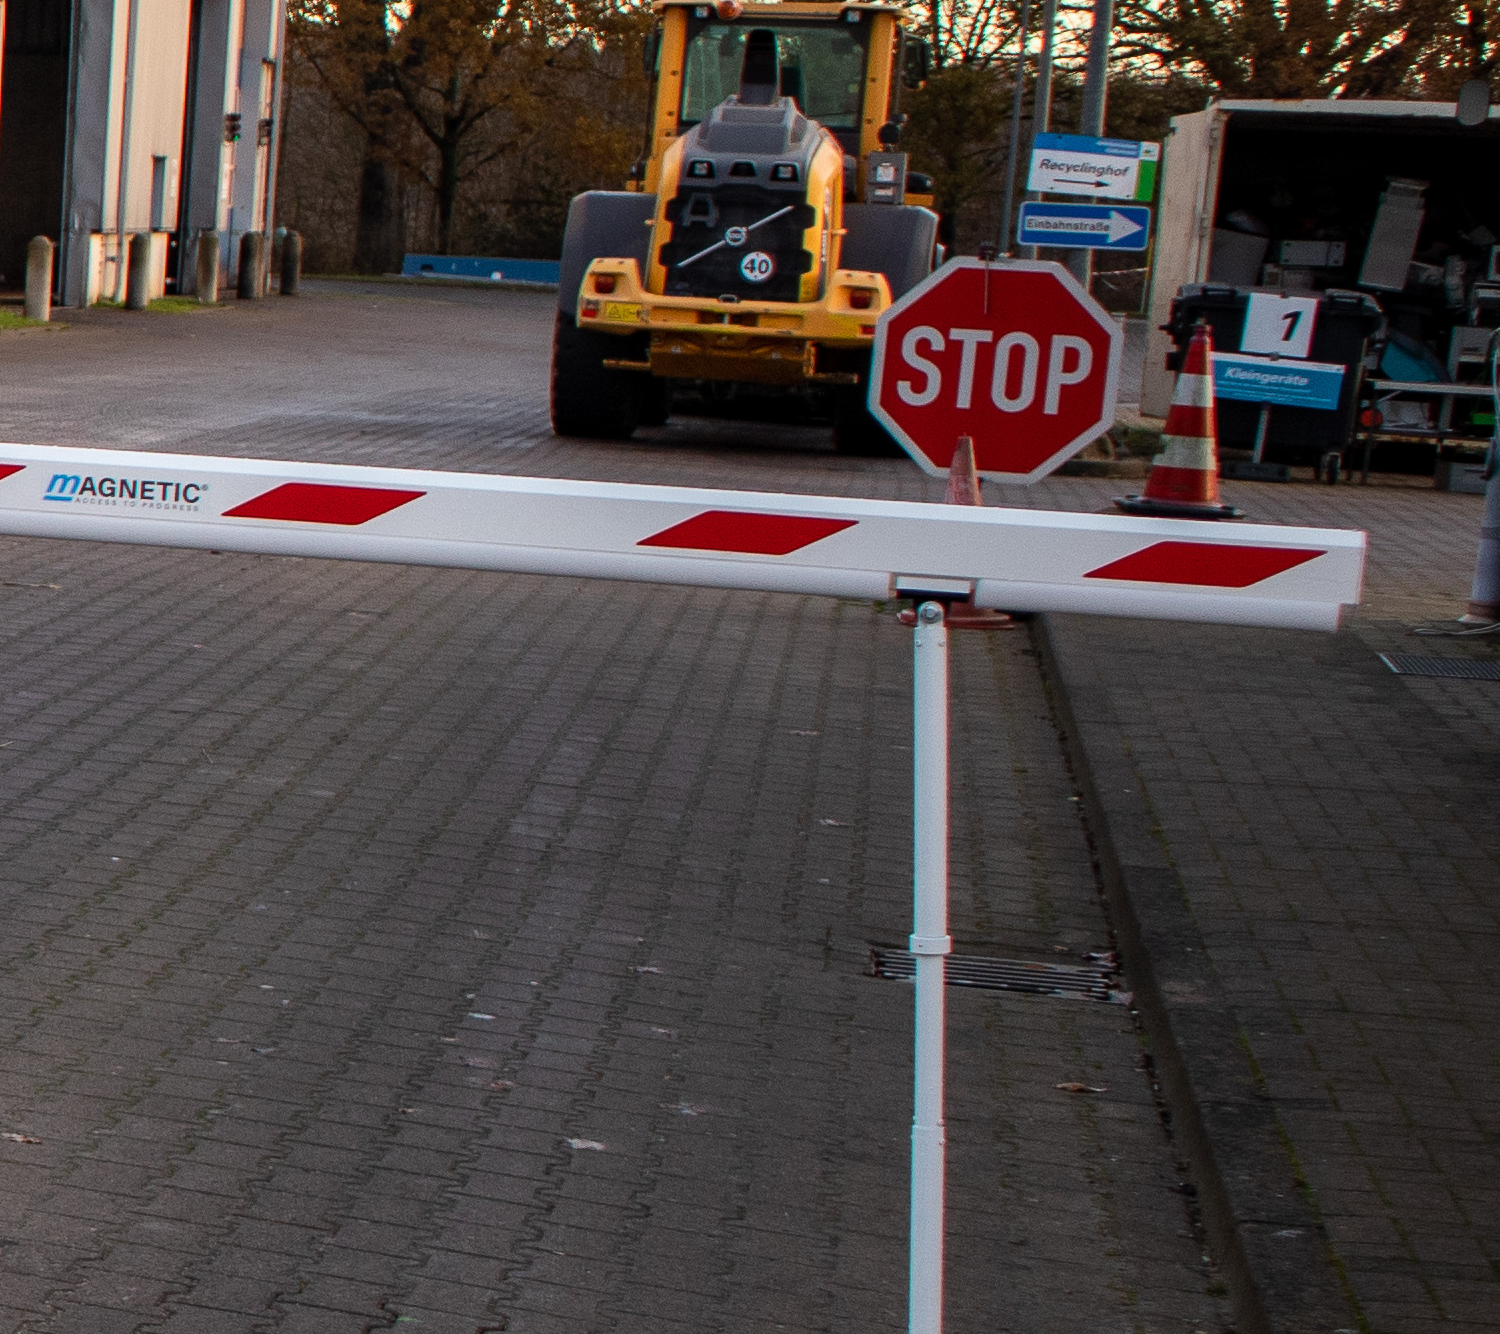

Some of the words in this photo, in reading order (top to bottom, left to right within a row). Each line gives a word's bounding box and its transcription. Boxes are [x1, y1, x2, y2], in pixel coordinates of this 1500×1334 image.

[1039, 158, 1130, 177] Recyclinghof
[1027, 218, 1110, 232] Einbahnstraße
[743, 258, 771, 274] 40
[1281, 310, 1303, 342] 1
[896, 325, 1094, 415] STOP
[1225, 367, 1310, 386] Kleingeräte
[75, 497, 117, 506] ACCESS
[123, 500, 136, 508] TO
[141, 502, 199, 512] PROGRESS
